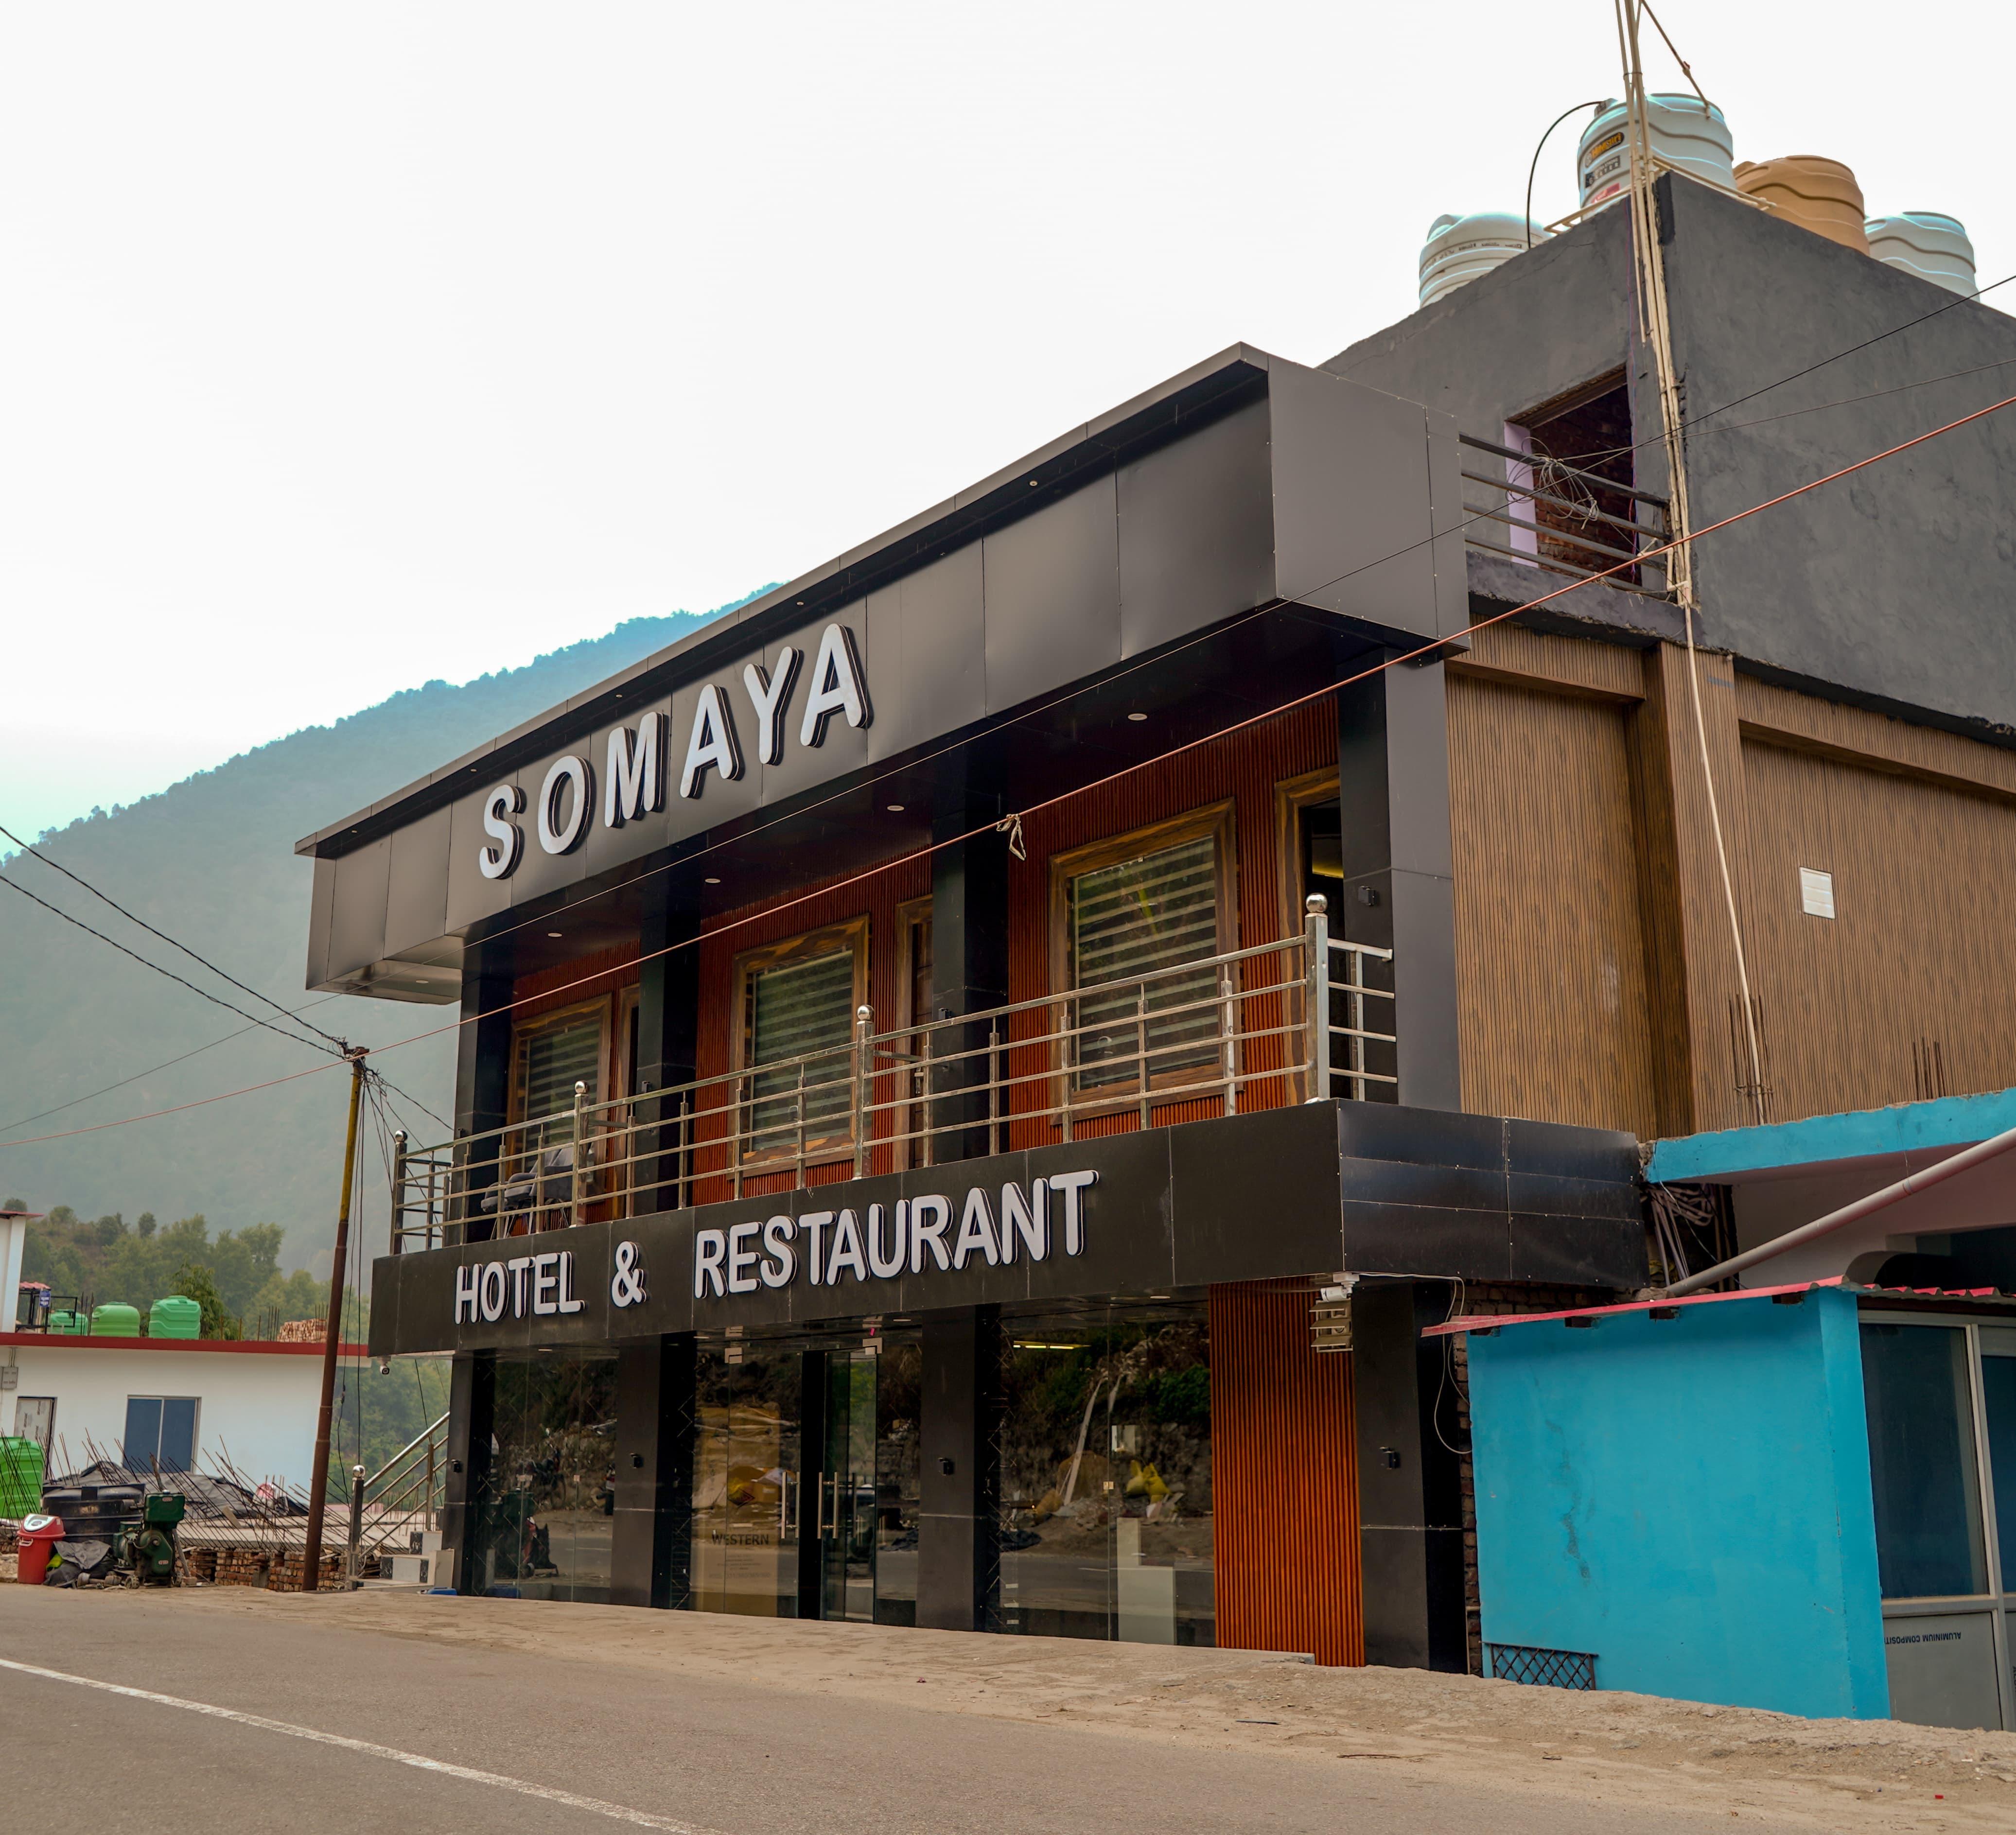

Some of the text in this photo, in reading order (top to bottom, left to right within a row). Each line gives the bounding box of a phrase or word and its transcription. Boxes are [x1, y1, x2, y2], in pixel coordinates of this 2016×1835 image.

[479, 623, 869, 879] SOMAYA
[455, 1170, 1099, 1324] HOTEL & RESTAURANT
[712, 1534, 769, 1545] WESTERN
[1922, 1632, 1961, 1642] ALUMINIUM
